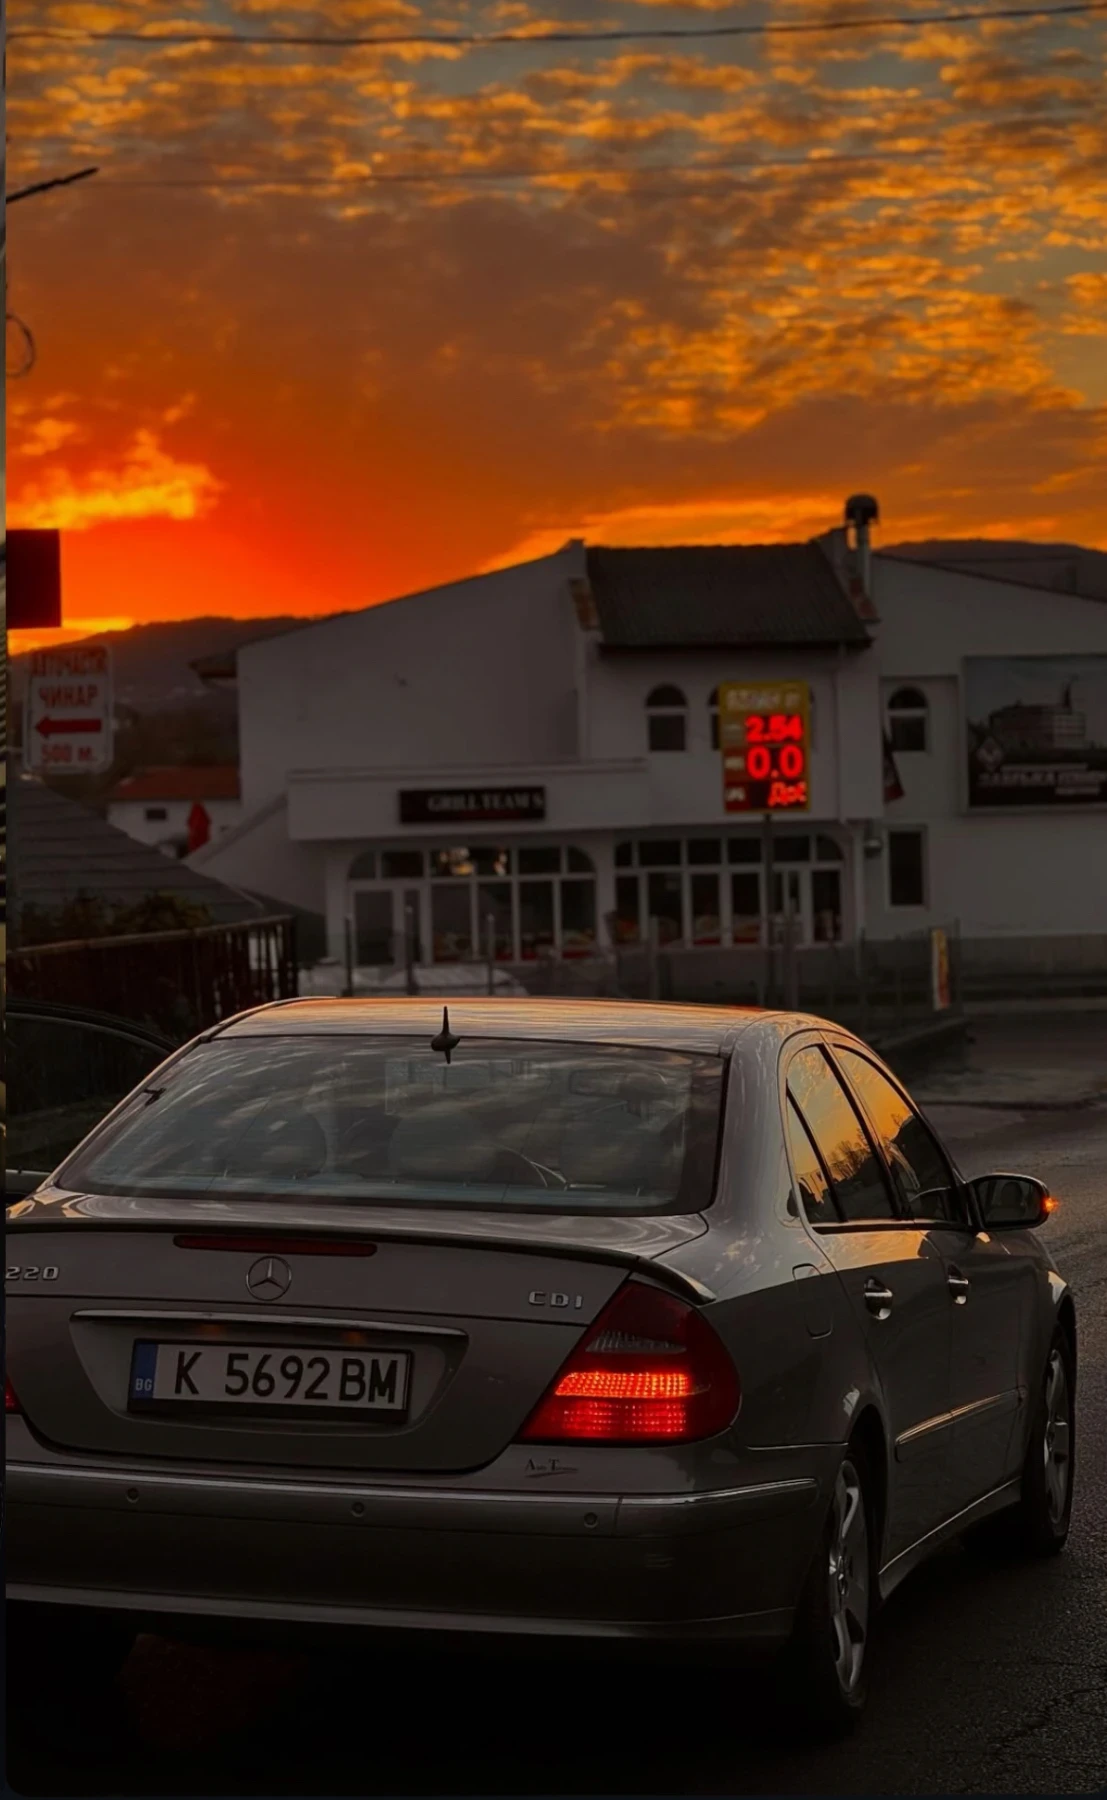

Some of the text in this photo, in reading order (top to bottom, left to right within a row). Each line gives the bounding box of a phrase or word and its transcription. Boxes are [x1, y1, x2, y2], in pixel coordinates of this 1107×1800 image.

[39, 685, 98, 708] ЧИНАР
[745, 714, 803, 742] 2.54
[747, 744, 803, 779] 0.0
[428, 793, 479, 811] GRILL
[6, 1266, 59, 1280] 220
[528, 1291, 583, 1308] CDI
[135, 1351, 398, 1404] BG K 5692 BM
